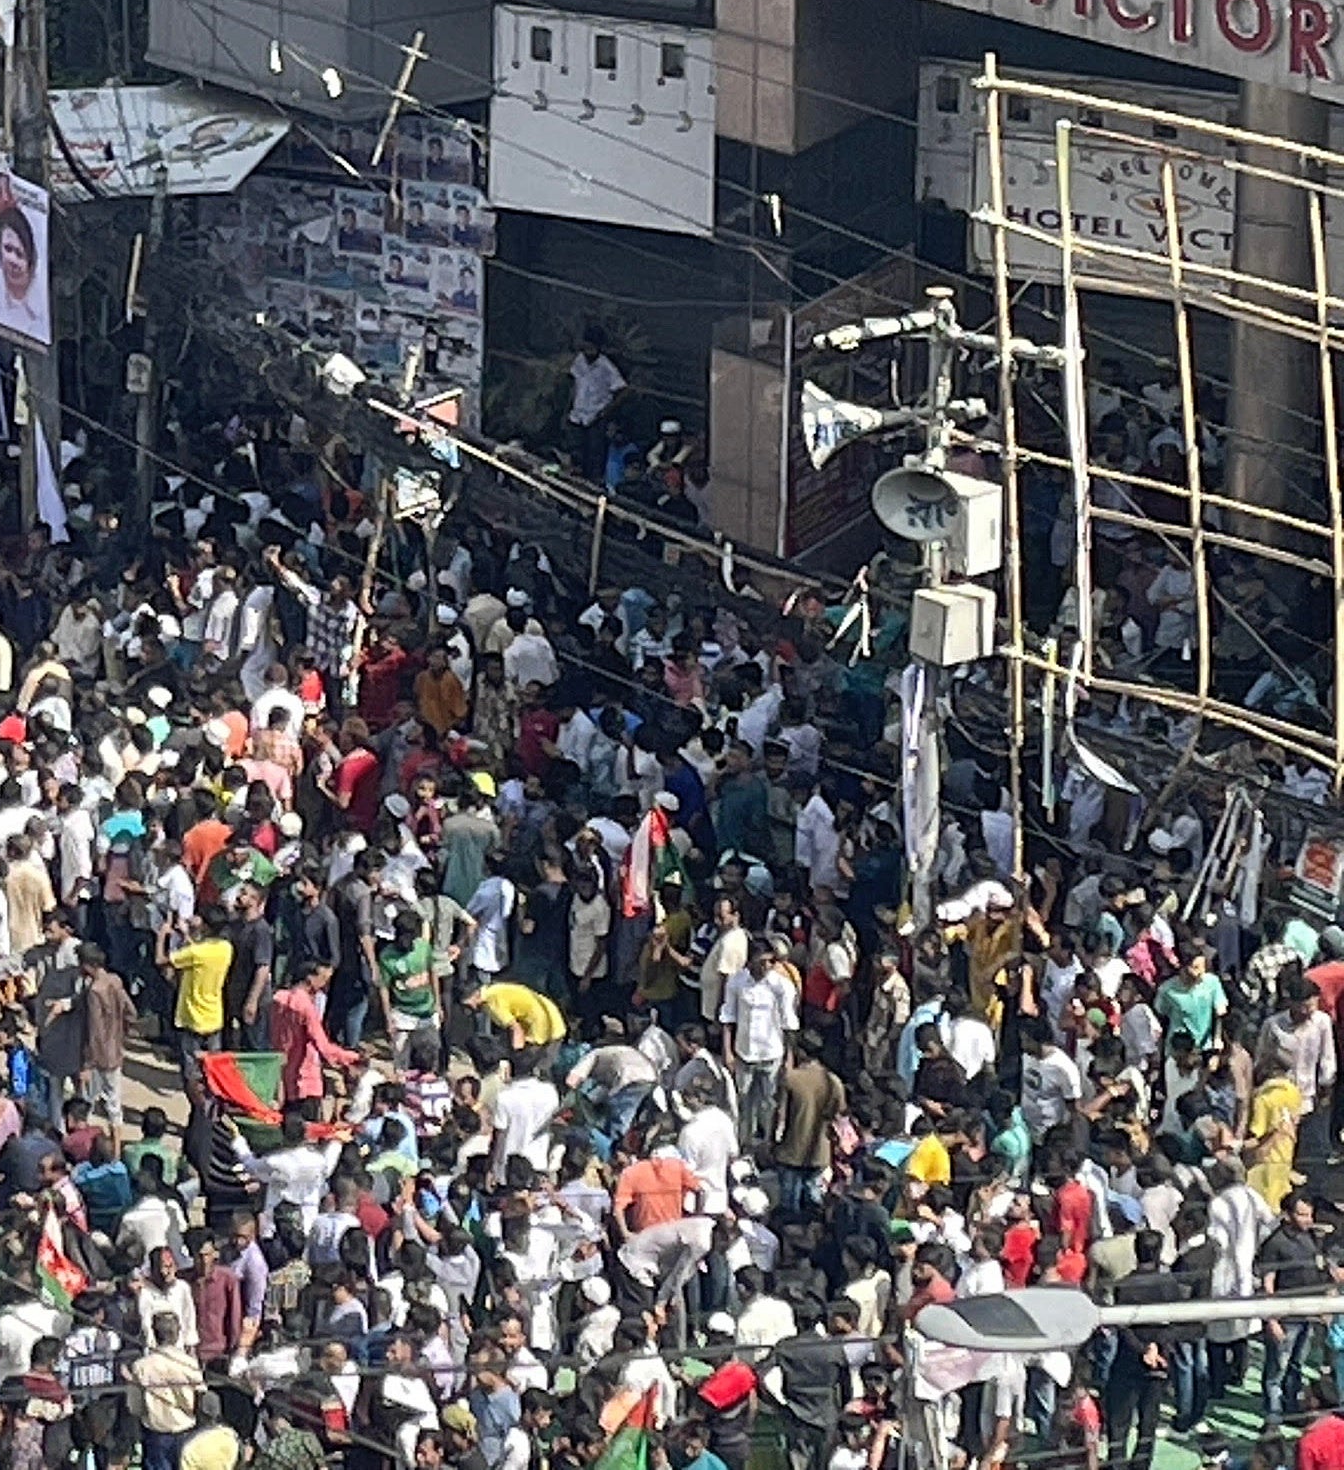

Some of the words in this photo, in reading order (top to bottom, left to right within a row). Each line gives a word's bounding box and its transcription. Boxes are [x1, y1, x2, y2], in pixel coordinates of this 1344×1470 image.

[1096, 156, 1233, 212] WELOME
[1005, 204, 1132, 239] HOTEL
[1147, 221, 1235, 251] VICT
